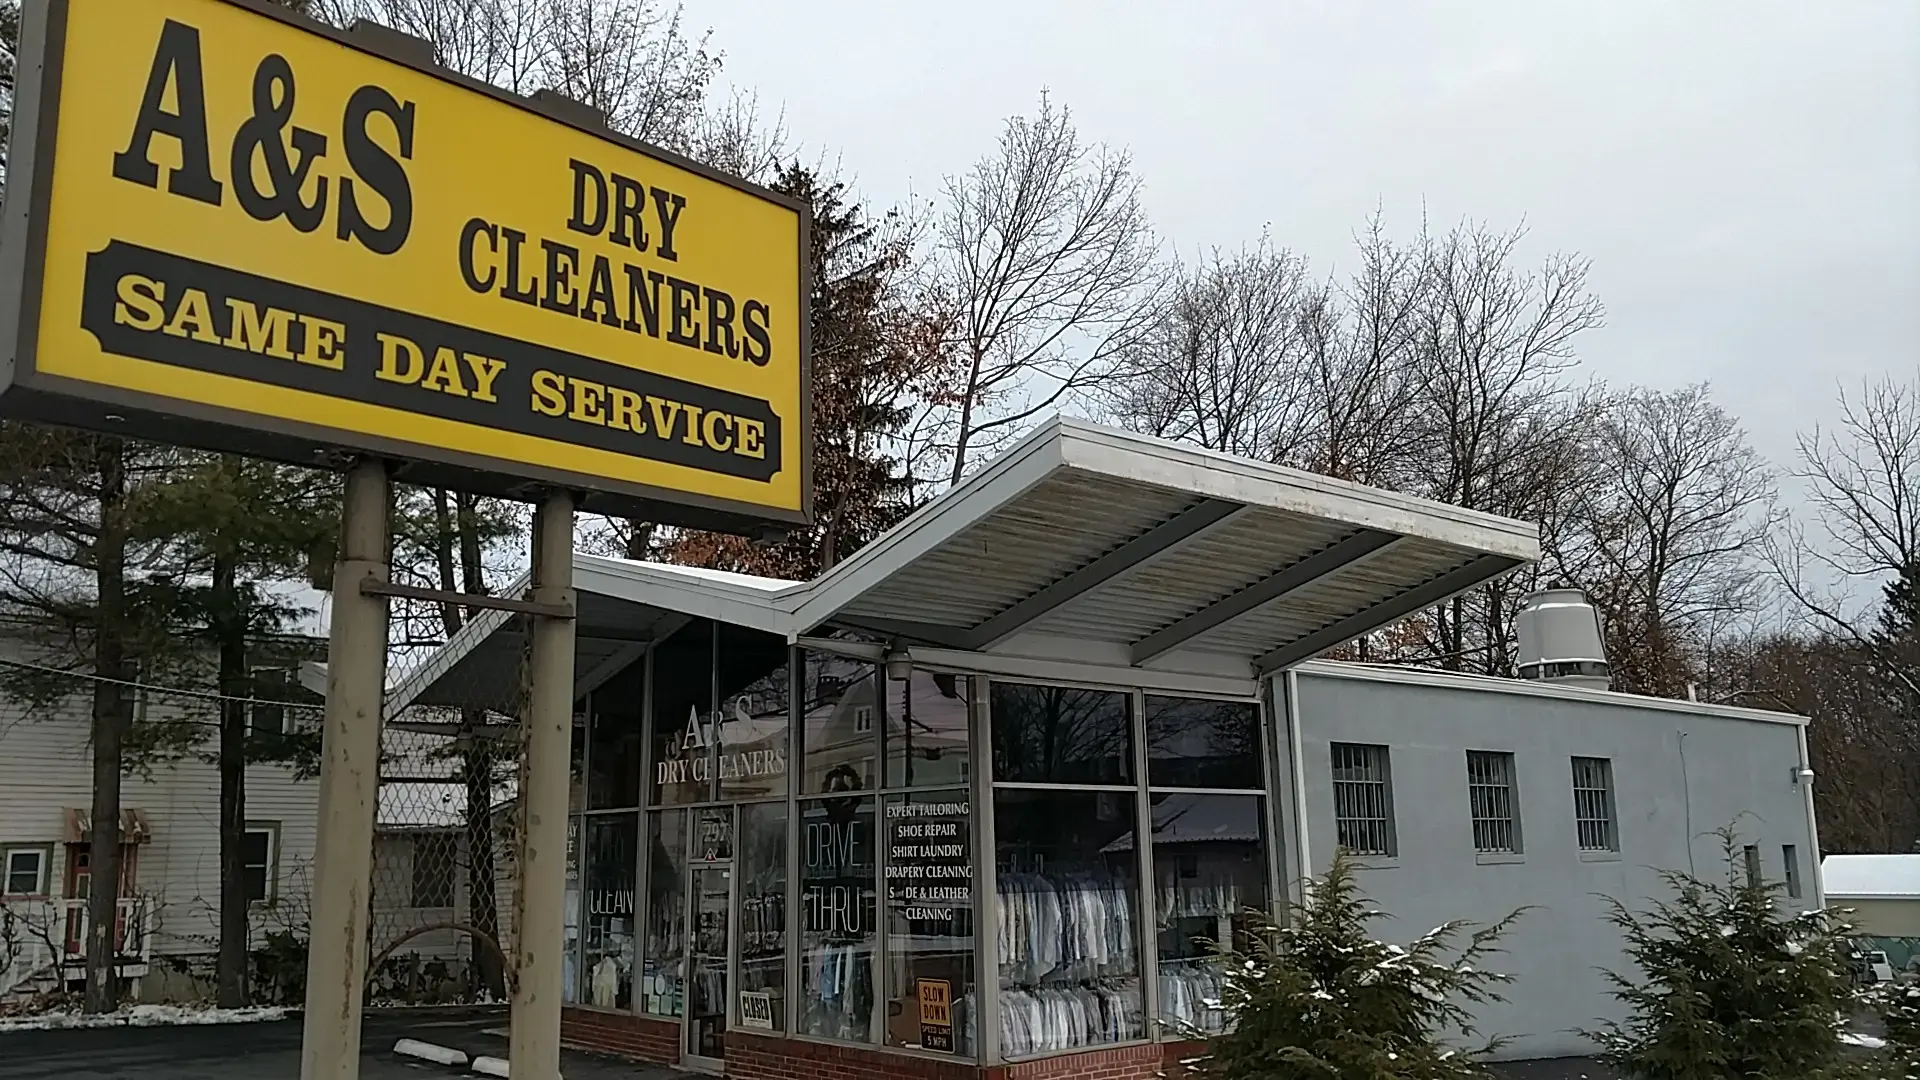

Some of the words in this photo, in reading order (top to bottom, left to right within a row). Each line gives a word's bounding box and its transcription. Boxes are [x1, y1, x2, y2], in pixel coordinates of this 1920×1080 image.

[112, 17, 417, 256] A&S
[566, 157, 687, 263] DRY
[457, 216, 772, 368] CLEANERS
[113, 273, 347, 371] SAME
[375, 331, 507, 404] DAY
[529, 367, 767, 461] SERVICE
[656, 758, 689, 785] DRY
[886, 804, 917, 818] EXPERT
[919, 802, 970, 816] TAILORING
[897, 824, 923, 838] SHOE
[924, 823, 957, 837] REPAIR
[807, 820, 863, 868] DRIVE
[891, 845, 919, 858] SHIRT
[920, 844, 964, 857] LAUNDRY
[885, 866, 925, 879] DRAPERY
[925, 865, 973, 878] CLEANING
[589, 882, 635, 914] CLEAN
[889, 886, 918, 899] SDE
[919, 886, 927, 899] &
[928, 886, 970, 899] LEATHER
[809, 884, 861, 933] THRU
[905, 907, 953, 921] CLEANING
[923, 985, 944, 1002] SLOW
[742, 995, 770, 1020] CLOSED
[923, 1004, 947, 1021] DOWN
[921, 1025, 938, 1034] SPEED
[927, 1035, 932, 1046] 5
[933, 1036, 948, 1048] MPH
